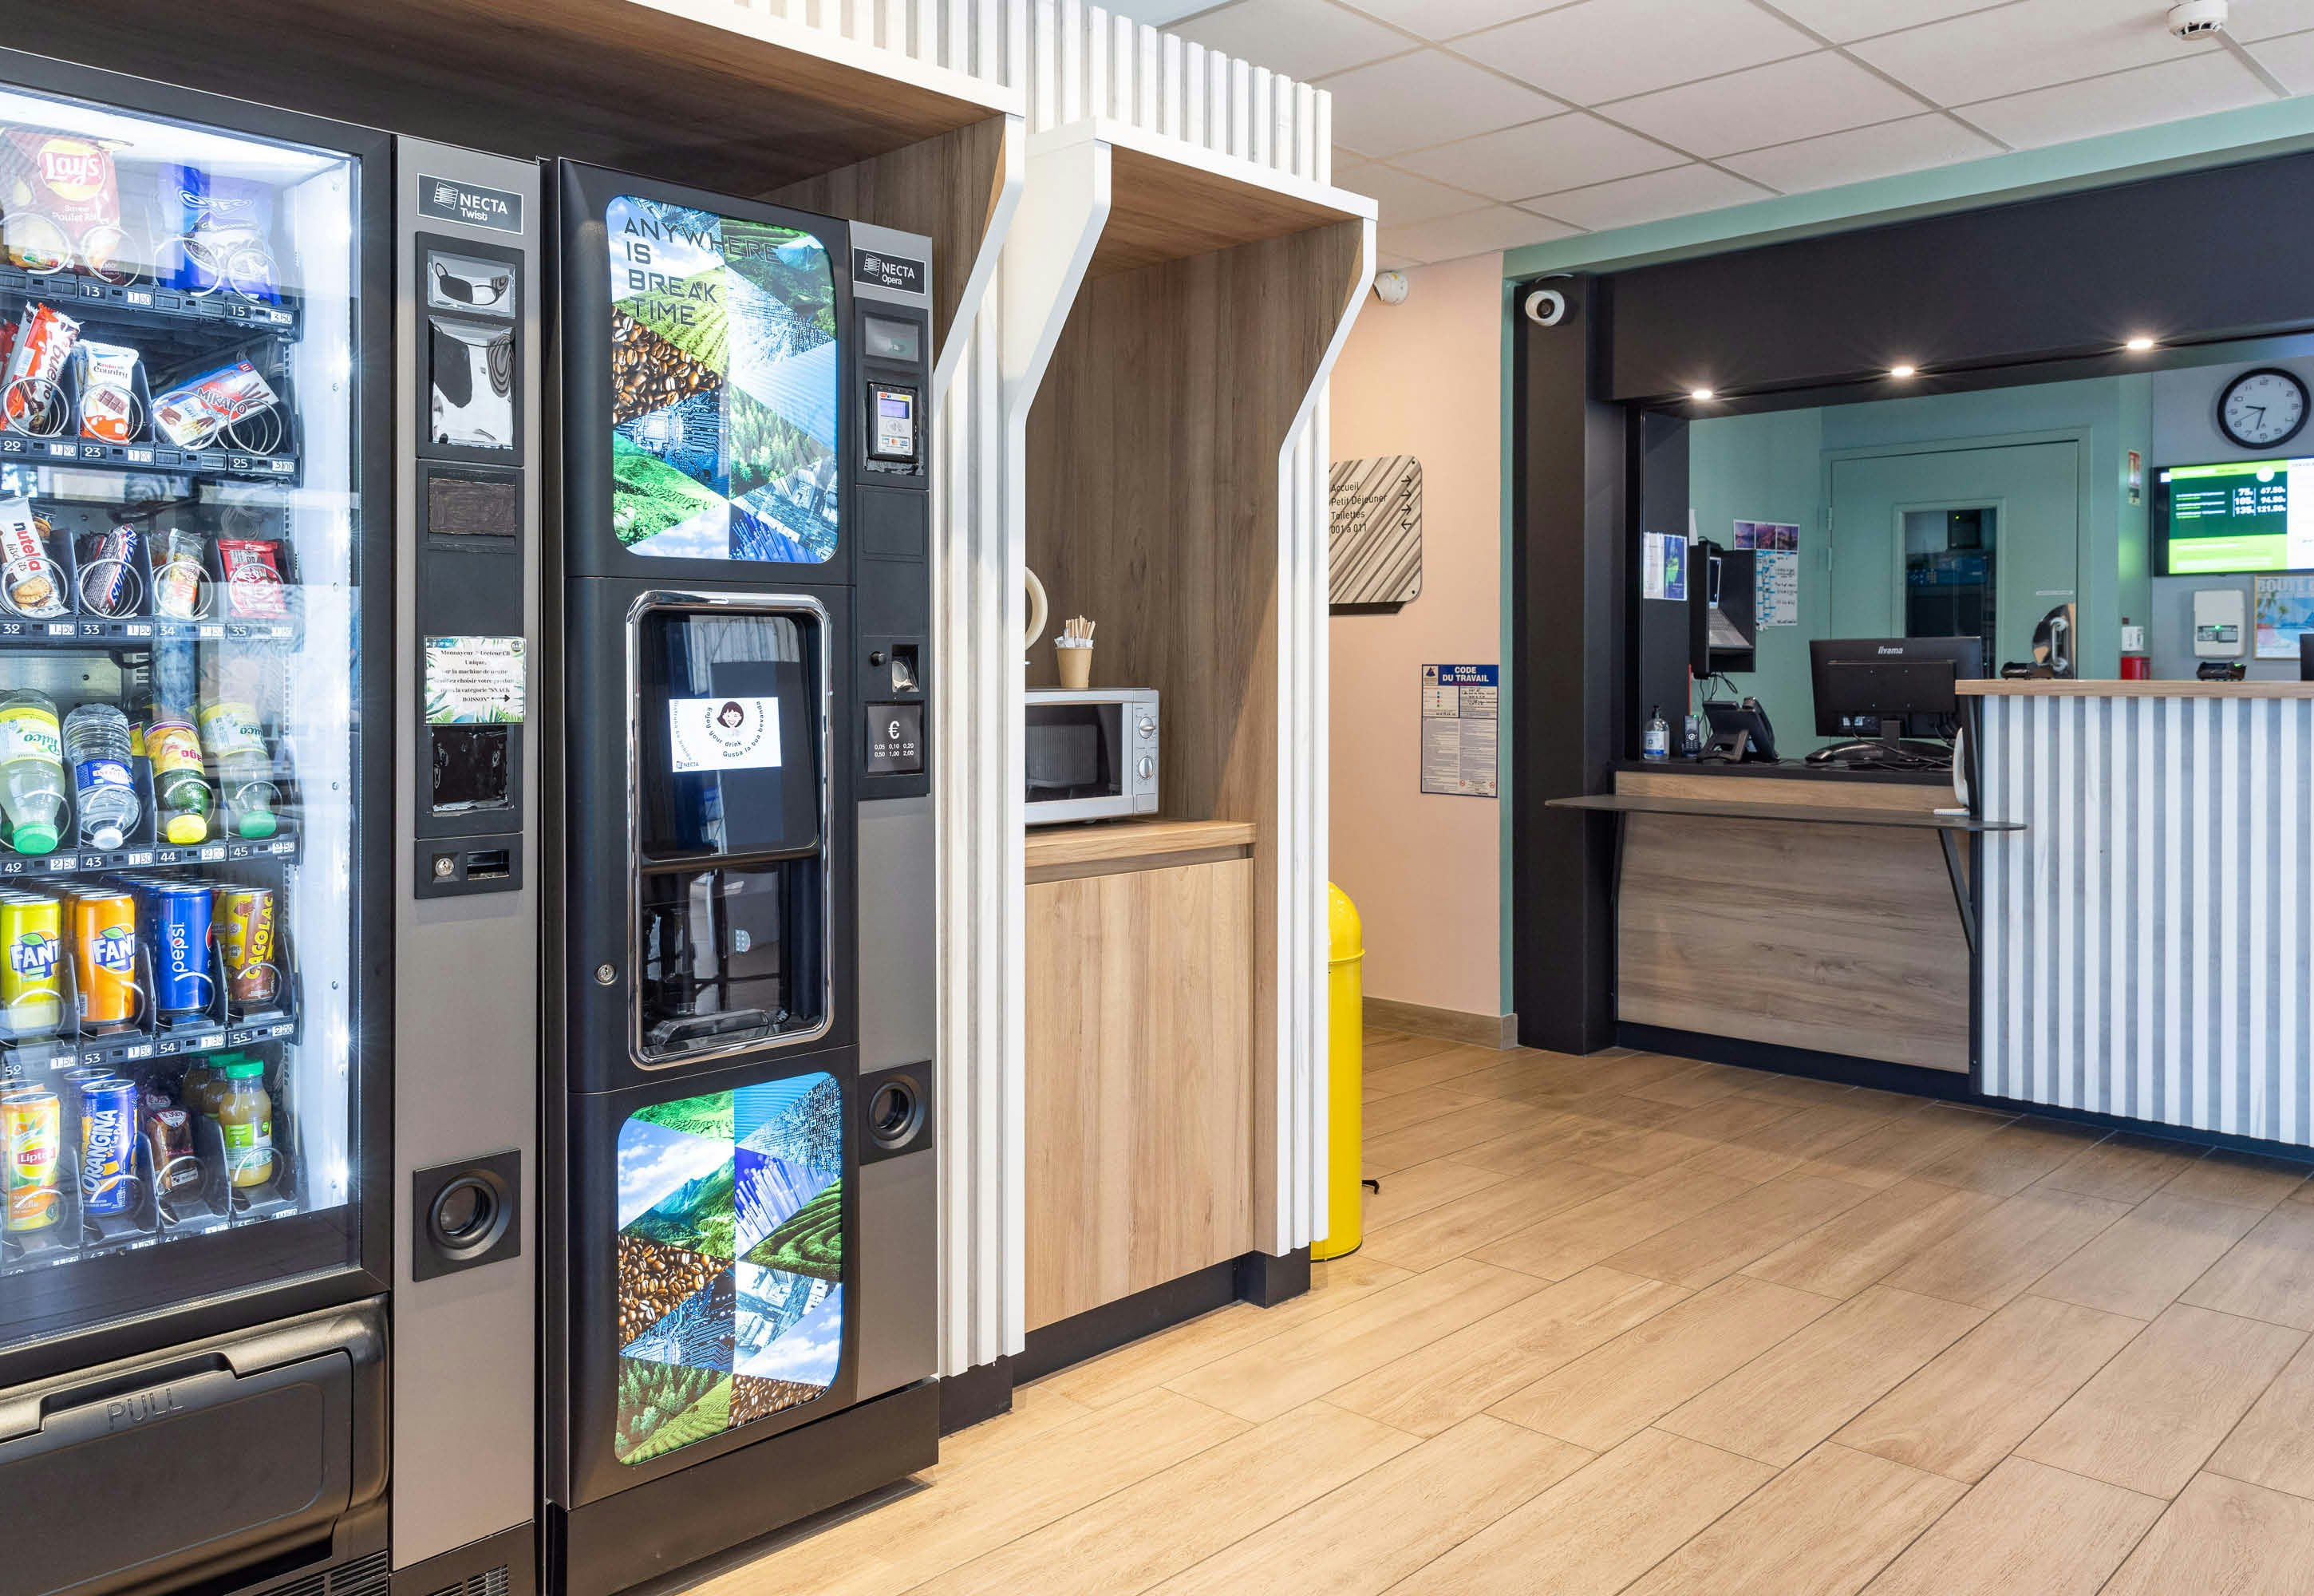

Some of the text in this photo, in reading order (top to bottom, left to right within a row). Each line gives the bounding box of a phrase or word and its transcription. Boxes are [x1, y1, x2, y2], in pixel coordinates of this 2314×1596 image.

[460, 193, 508, 215] NECTA
[460, 207, 488, 221] Twist
[624, 216, 780, 264] ANYWHERE
[626, 241, 651, 264] IS
[882, 262, 915, 279] NECTA
[629, 269, 717, 303] BREAK
[882, 275, 902, 285] Opera
[83, 285, 100, 297] 13
[232, 306, 246, 317] 15
[629, 296, 696, 326] TIME
[43, 345, 67, 400] bueno
[198, 388, 248, 414] MIKADO
[3, 440, 21, 452] 22
[85, 447, 101, 457] 23
[233, 458, 247, 468] 25
[1331, 482, 1360, 492] Accueil
[1331, 494, 1388, 507] Petit Déjeuner
[1331, 512, 1365, 520] Toilettes
[1331, 525, 1344, 534] 001
[13, 522, 41, 571] nutella
[3, 623, 20, 634] 32
[83, 624, 100, 634] 33
[160, 626, 176, 636] 34
[232, 626, 247, 637] 35
[756, 701, 764, 733] bevanda
[705, 707, 713, 729] Enjoy
[709, 730, 723, 744] your
[888, 721, 900, 739] €
[160, 851, 176, 861] 44
[233, 847, 248, 856] 45
[85, 856, 102, 867] 43
[5, 863, 22, 873] 42
[245, 896, 273, 979] CACOLAC
[170, 922, 188, 972] pepsi
[233, 1033, 251, 1043] 55
[160, 1042, 176, 1053] 54
[85, 1053, 101, 1065] 53
[5, 1065, 22, 1076] 52
[81, 1109, 118, 1193] ORANGINA
[107, 1387, 185, 1432] PULL
